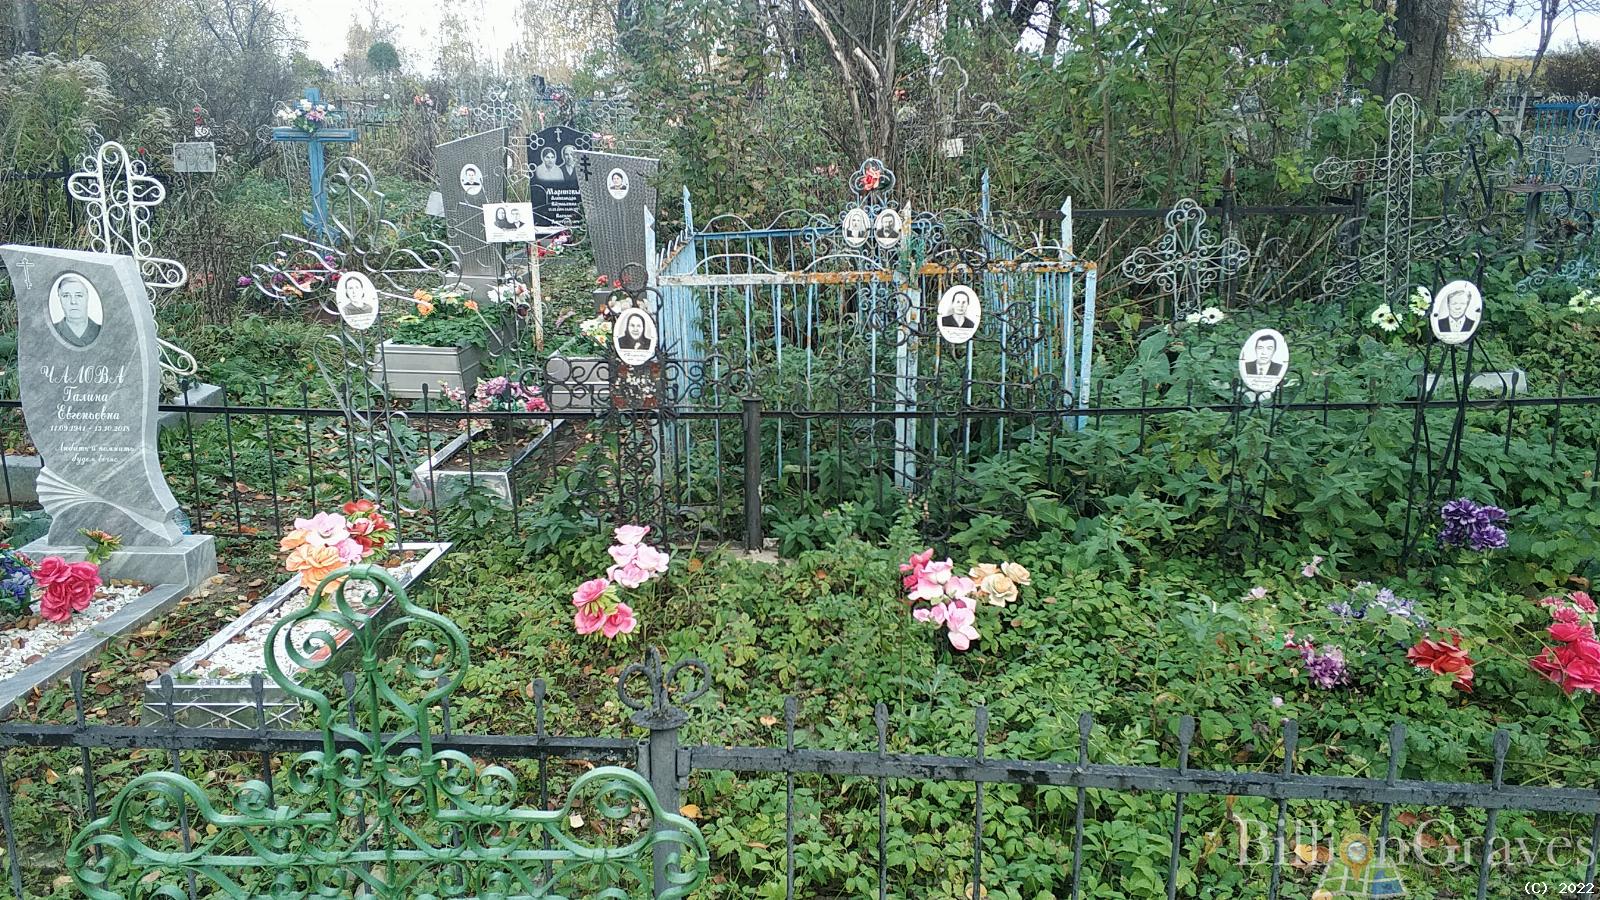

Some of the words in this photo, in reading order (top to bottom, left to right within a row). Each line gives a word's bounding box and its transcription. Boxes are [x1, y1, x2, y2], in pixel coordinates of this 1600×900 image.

[40, 365, 125, 384] ЧАЛОВА
[62, 386, 109, 402] Галина
[56, 403, 120, 420] Евгеньевна
